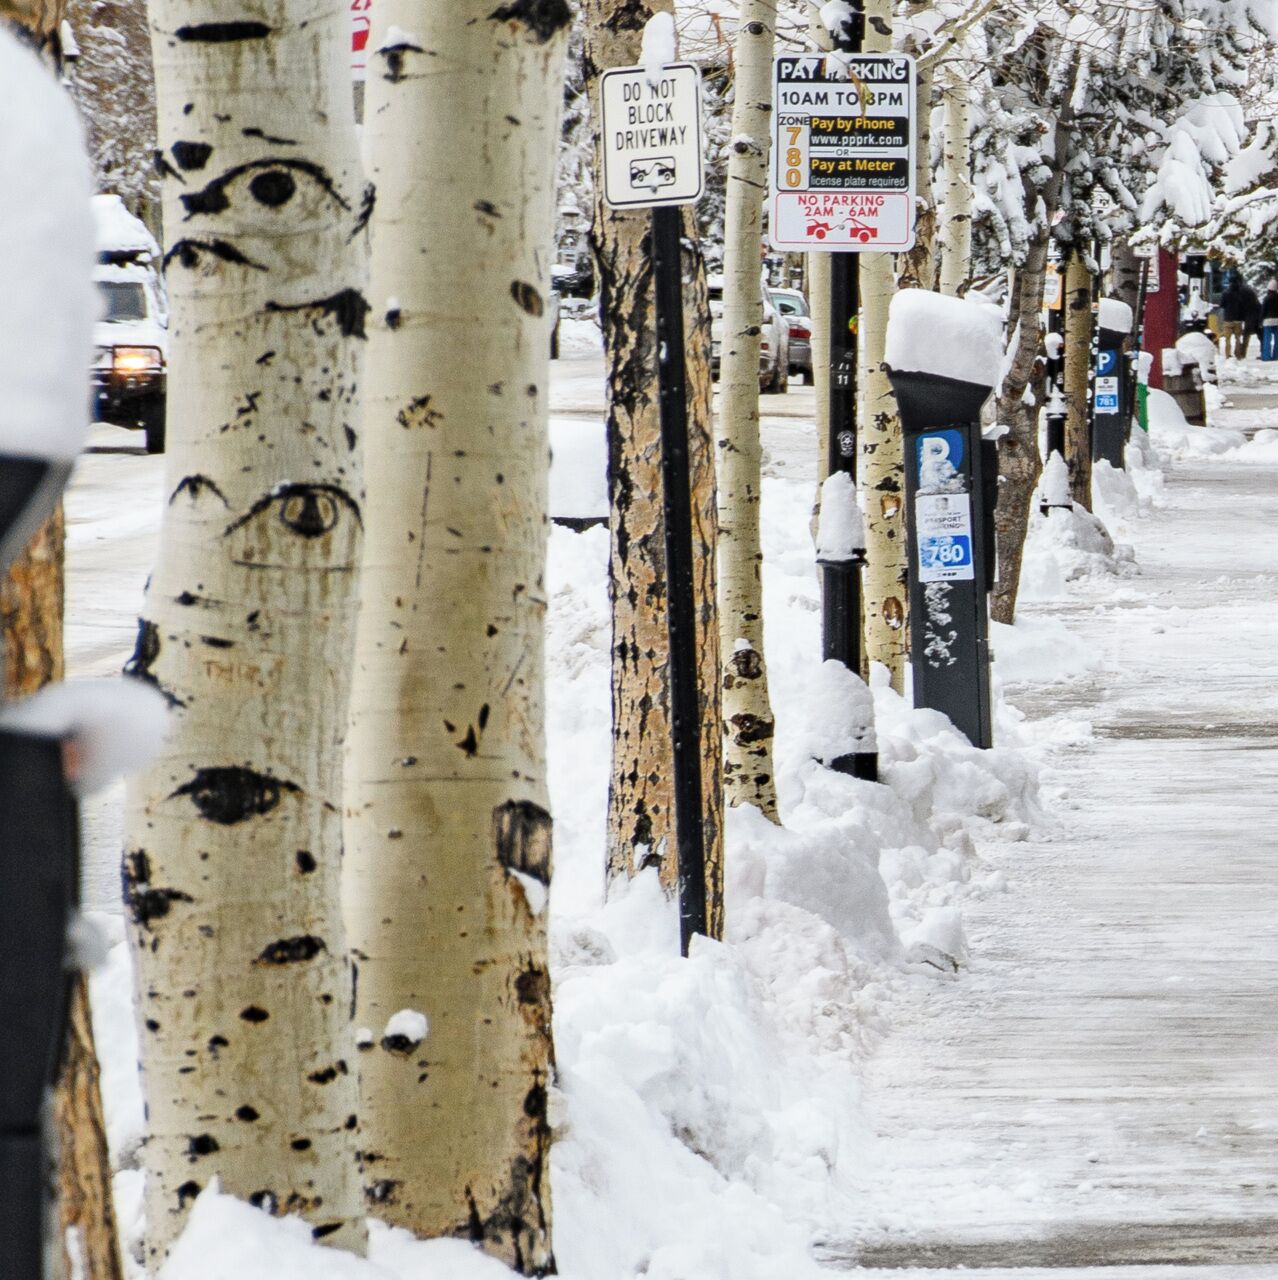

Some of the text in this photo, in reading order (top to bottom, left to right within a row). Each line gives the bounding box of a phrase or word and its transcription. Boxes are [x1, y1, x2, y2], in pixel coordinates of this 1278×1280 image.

[780, 61, 818, 80] PAY
[623, 79, 677, 102] DO NOT
[782, 91, 829, 106] 10AM
[836, 92, 859, 106] TO
[628, 102, 674, 125] BLOCK
[779, 116, 809, 126] ZONE
[812, 118, 896, 132] Pay by Phone
[616, 125, 687, 151] DRIVEWAY
[811, 134, 904, 146] www.ppprk.com
[836, 149, 849, 157] OR
[812, 160, 896, 173] Pay at Meter
[811, 176, 906, 188] license plate required
[798, 196, 885, 207] NO PARKING
[805, 207, 834, 217] 2AM
[849, 207, 879, 217] 6AM
[927, 545, 964, 562] 780
